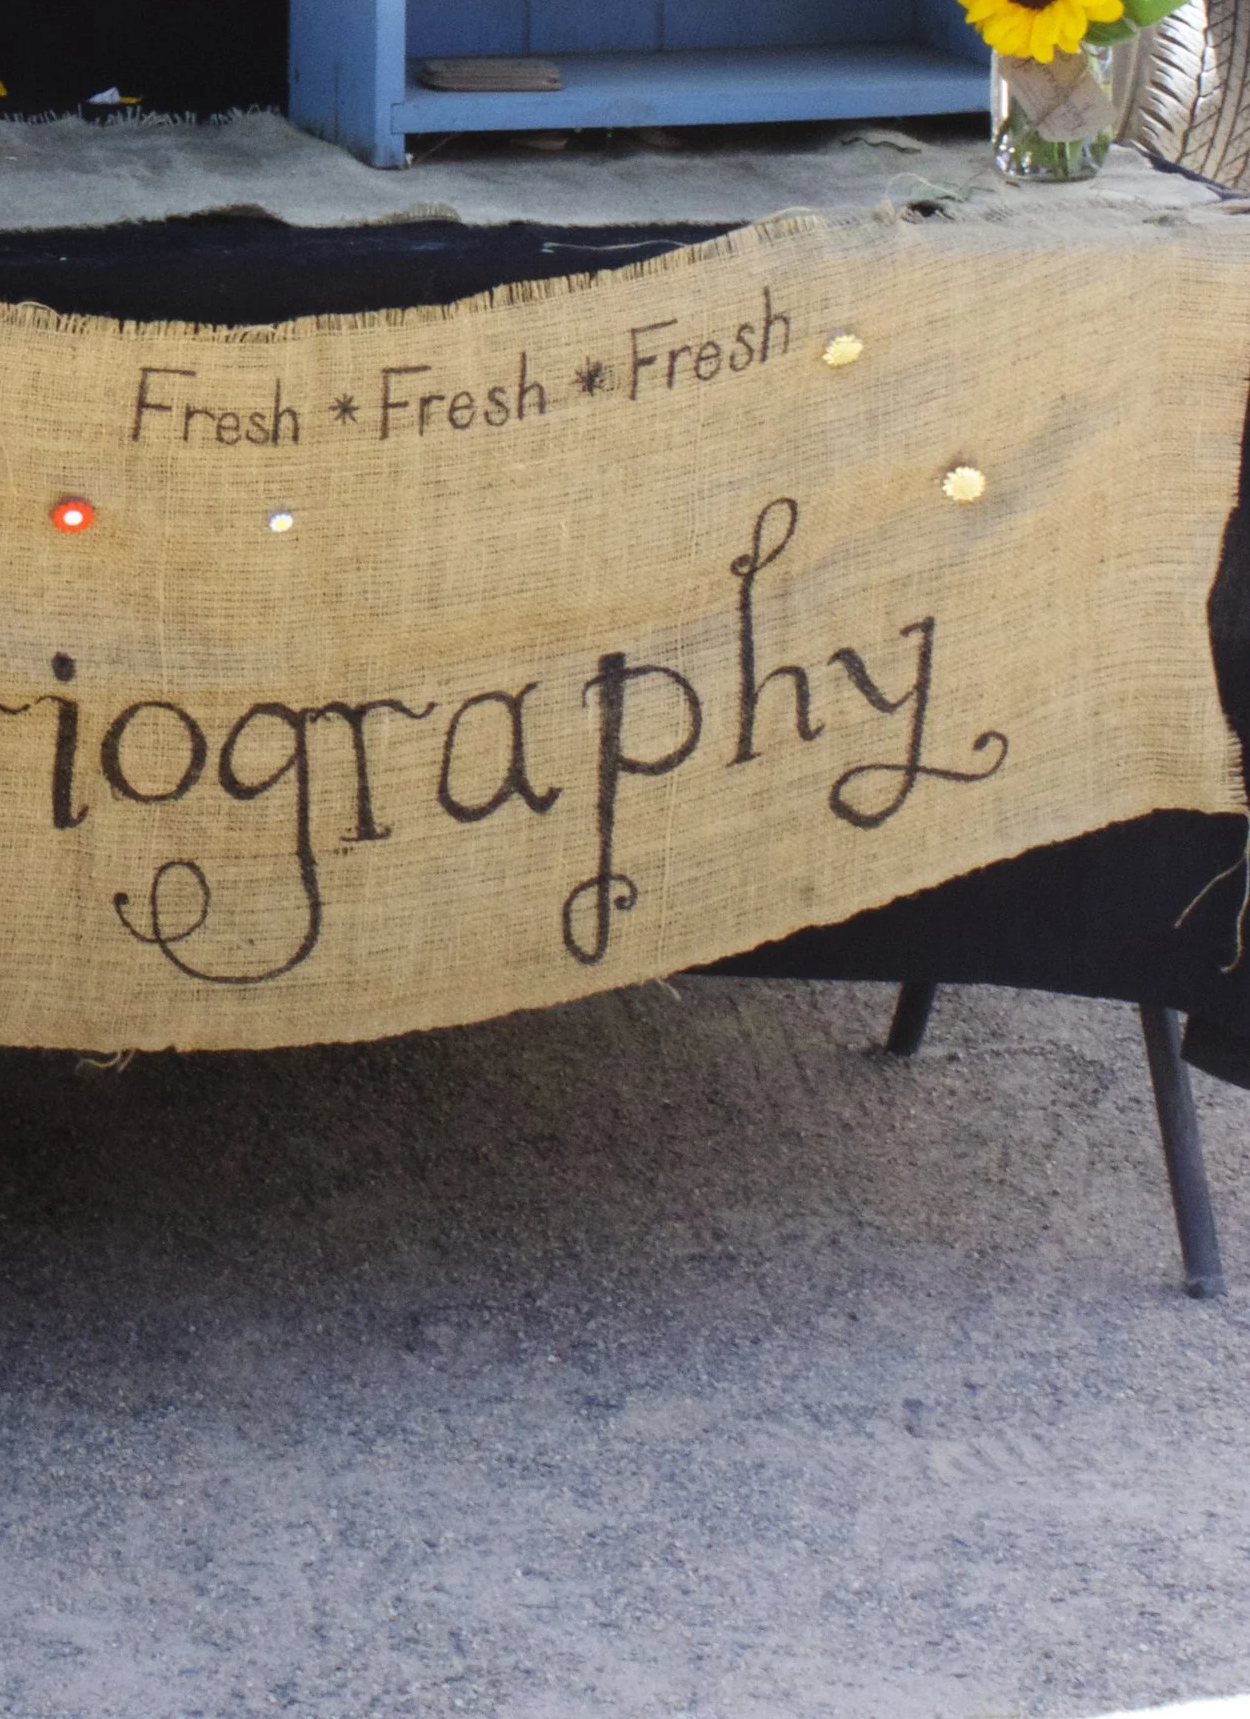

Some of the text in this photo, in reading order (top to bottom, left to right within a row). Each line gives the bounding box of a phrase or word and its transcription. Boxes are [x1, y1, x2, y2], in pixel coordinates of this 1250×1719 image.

[129, 284, 792, 446] Fresh Fresh Fresh
